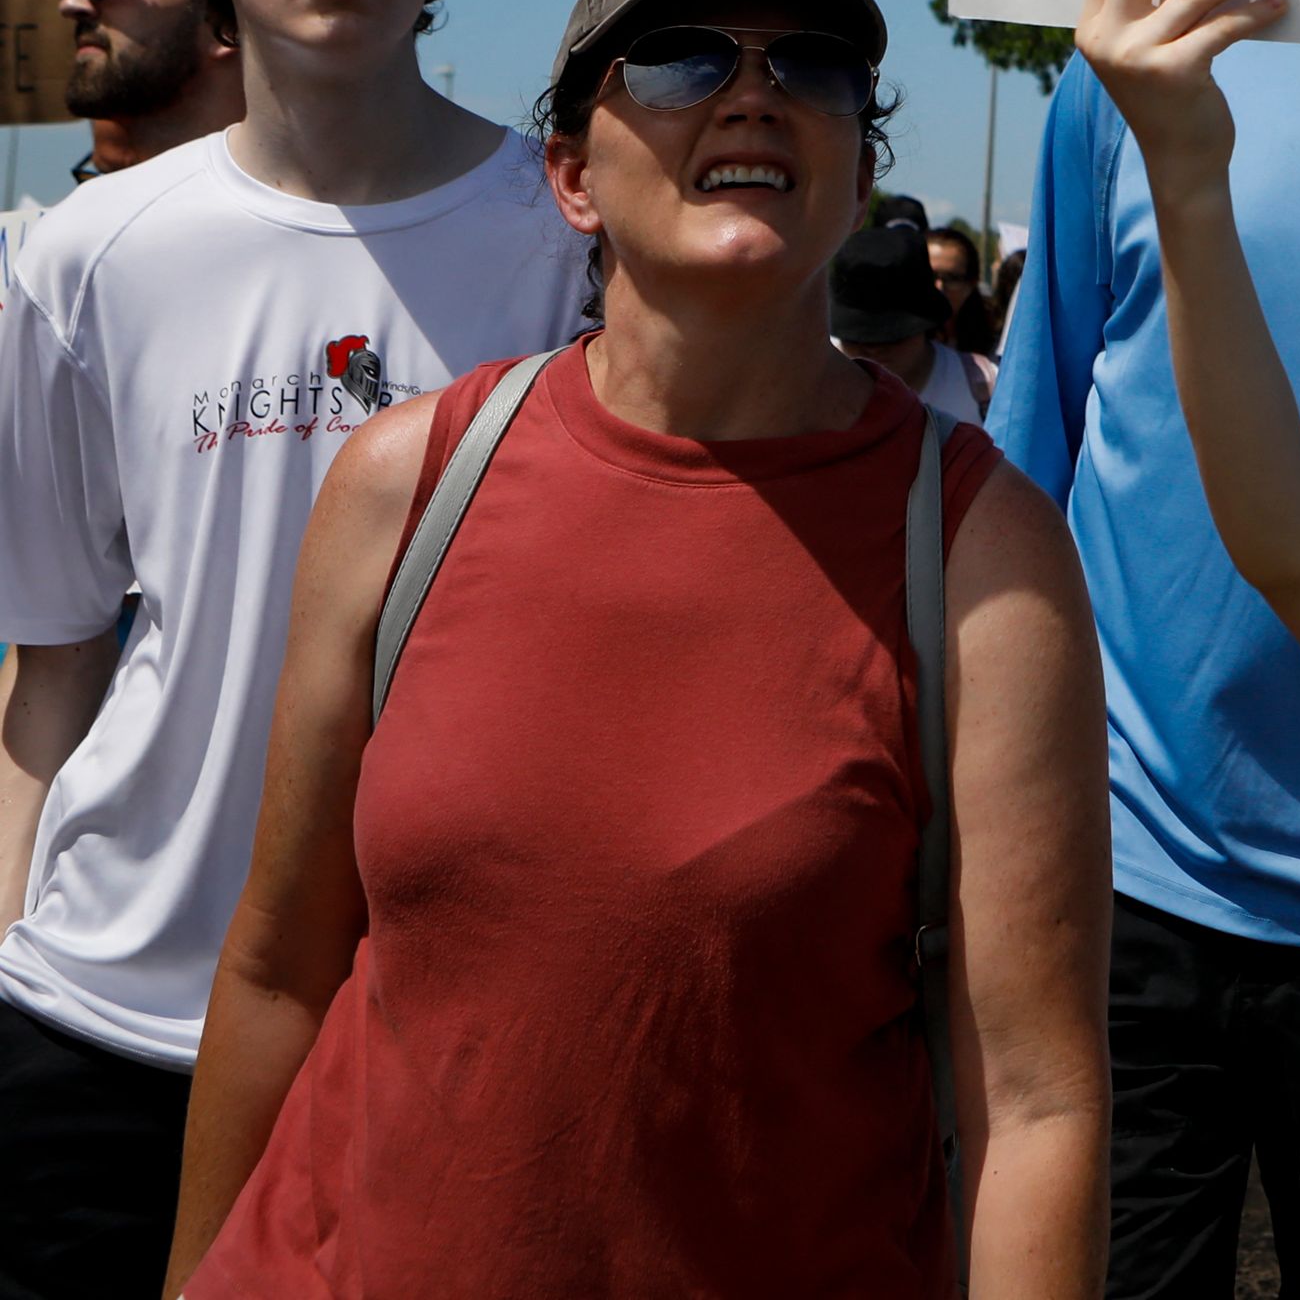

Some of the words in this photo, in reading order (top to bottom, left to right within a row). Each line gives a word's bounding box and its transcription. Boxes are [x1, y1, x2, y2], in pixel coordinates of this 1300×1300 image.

[193, 371, 321, 407] Monarch
[226, 417, 288, 441] Pride
[295, 416, 319, 441] of
